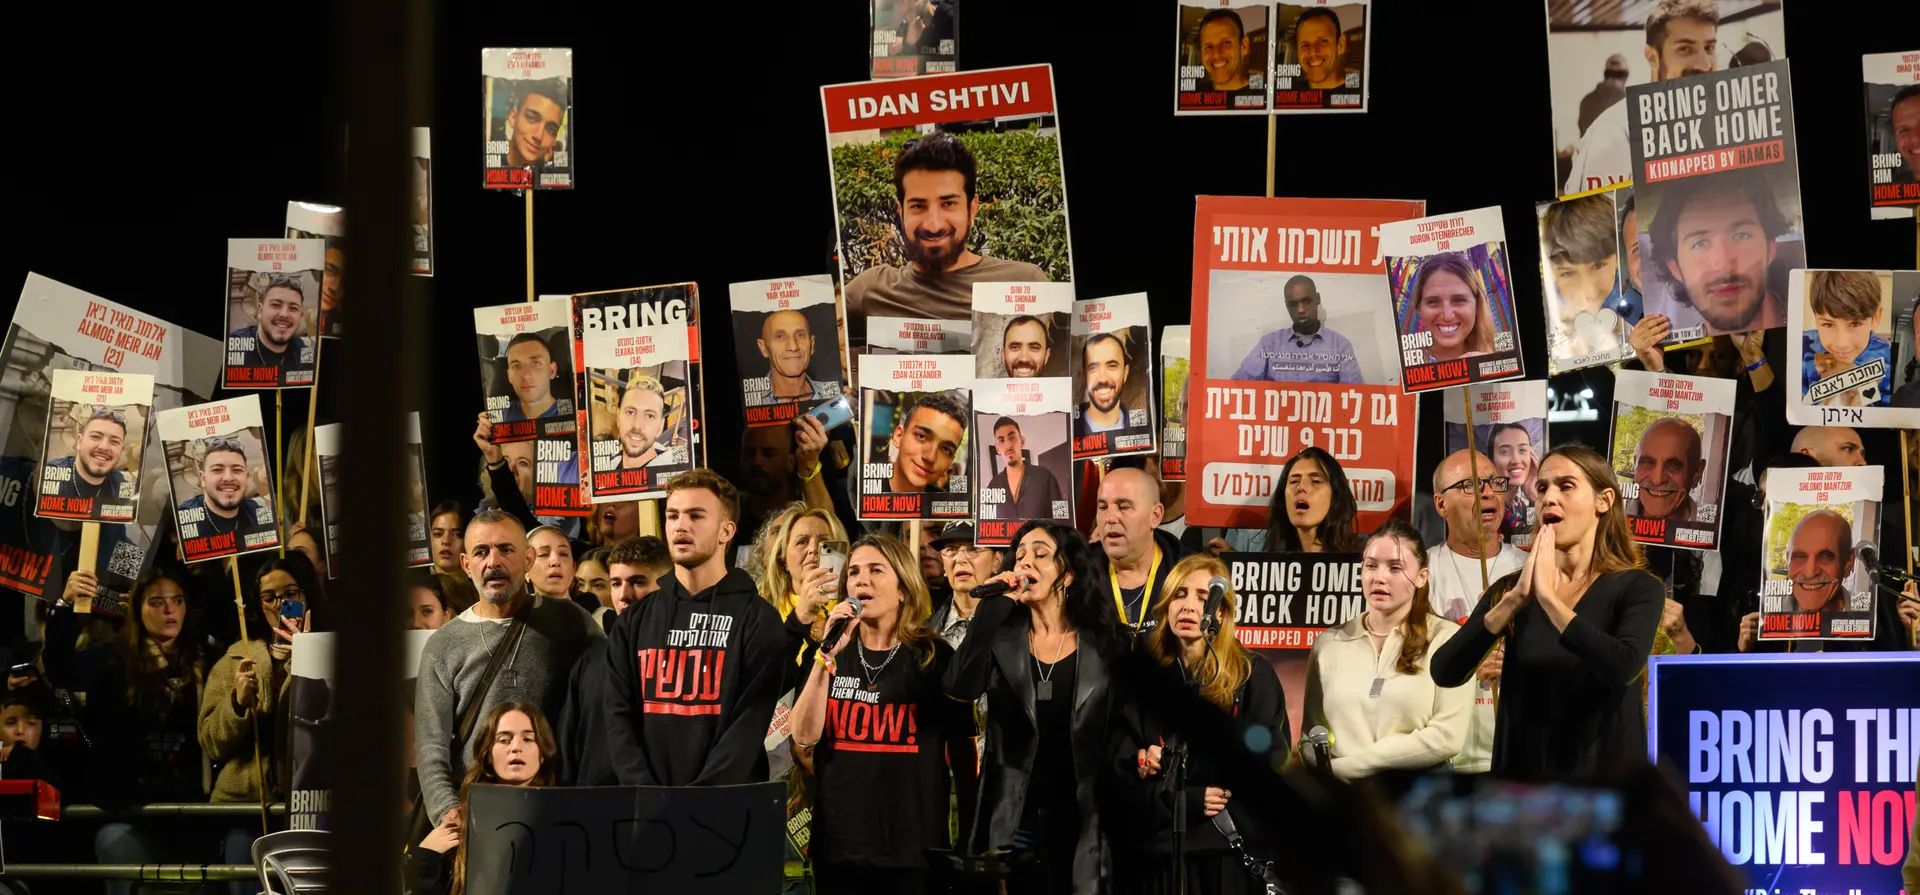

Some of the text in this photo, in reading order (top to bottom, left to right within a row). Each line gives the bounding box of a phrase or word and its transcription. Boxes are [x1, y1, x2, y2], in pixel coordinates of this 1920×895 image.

[1181, 65, 1205, 79] BRING
[1277, 64, 1300, 77] BRING
[1180, 78, 1196, 91] HIM
[1276, 77, 1292, 89] HIM
[848, 82, 1030, 120] IDAN SHTIVI
[1639, 72, 1779, 125] BRING OMER
[1642, 106, 1783, 158] BACK HOME
[1649, 143, 1780, 180] KIDNAPPED BY HAMAS
[1872, 153, 1902, 168] BRING
[1874, 169, 1892, 184] HIM
[1874, 184, 1900, 200] HOME
[1410, 226, 1474, 245] DORON STEINBRECHER
[1212, 226, 1361, 266] תשכחו אותי
[1437, 240, 1450, 251] (30)
[766, 289, 800, 300] YAIR YAAKOV
[1023, 286, 1031, 294] טל
[779, 300, 790, 308] (59)
[1005, 294, 1036, 303] TAL SHOHAM
[582, 299, 687, 332] BRING
[1014, 304, 1025, 312] (38)
[110, 308, 134, 331] מאיר
[500, 313, 539, 324] MATAN ANGREST
[134, 320, 167, 343] אלמוג
[515, 323, 526, 332] (21)
[899, 331, 946, 340] ROM BRASLAVSKI
[77, 319, 162, 361] ALMOG MEIR JAN
[229, 337, 255, 351] BRING
[917, 340, 928, 349] (19)
[1401, 331, 1433, 350] BRING
[103, 346, 125, 368] (21)
[615, 343, 656, 357] ELKANA BOHBOT
[228, 352, 244, 366] HIM
[630, 356, 641, 366] (34)
[924, 361, 936, 369] עידן
[1403, 350, 1424, 367] HER
[227, 366, 278, 381] HOME NOW!
[893, 370, 941, 379] EDAN ALEXANDER
[1406, 364, 1436, 385] HOME
[1438, 358, 1468, 380] NOW!
[743, 377, 770, 392] BRING
[911, 380, 922, 389] (19)
[1675, 380, 1694, 390] שלמה
[1813, 364, 1882, 399] מחכה לאבא
[487, 395, 510, 410] BRING
[744, 392, 762, 407] HIM
[1649, 388, 1703, 402] SHLOMO MANTZUR
[746, 401, 799, 421] HOME NOW!
[1205, 387, 1398, 425] גם לי מחכים בבית
[1488, 401, 1515, 410] ARGAMANI
[1666, 400, 1680, 410] (85)
[188, 414, 231, 428] ALMOG MEIR JAN
[1822, 407, 1863, 425] איתן
[206, 426, 216, 434] (21)
[513, 420, 536, 436] NOW!
[593, 440, 620, 456] BRING
[1083, 432, 1107, 450] NOW!
[1238, 424, 1289, 457] שנים
[1322, 428, 1363, 460] כבר
[537, 440, 571, 461] BRING
[594, 455, 610, 471] HIM
[863, 463, 893, 478] BRING
[44, 466, 71, 481] BRING
[536, 462, 558, 483] HIM
[594, 470, 619, 489] HOME
[621, 466, 648, 486] NOW!
[1824, 472, 1842, 480] שלמה
[42, 481, 60, 495] HIM
[863, 479, 882, 494] HIM
[1799, 482, 1852, 491] SHLOMO MANTZUR
[536, 486, 566, 507] HOME
[862, 495, 921, 512] HOME NOW!
[980, 488, 1006, 504] BRING
[1816, 492, 1829, 502] (85)
[40, 496, 93, 513] HOME NOW!
[980, 504, 997, 519] HIM
[178, 507, 205, 524] BRING
[181, 524, 199, 539] HIM
[979, 522, 1004, 537] HOME
[1636, 518, 1665, 536] NOW!
[184, 538, 210, 554] HOME
[212, 531, 236, 549] NOW!
[1232, 561, 1363, 593] BRING OME
[1765, 580, 1792, 596] BRING
[1234, 594, 1362, 625] BACK HOM
[1764, 596, 1782, 612] HIM
[689, 613, 733, 631] מחזירים
[1763, 614, 1789, 632] HOME
[1792, 612, 1820, 631] NOW!
[699, 630, 729, 647] אותם
[638, 648, 725, 701] עכשיו
[833, 676, 860, 689] BRING
[831, 687, 880, 704] THEM HOME
[826, 699, 918, 744] NOW!
[1689, 708, 1834, 784] BRING
[787, 807, 812, 834] BRING
[794, 826, 811, 847] HER
[495, 809, 751, 895] עסקה
